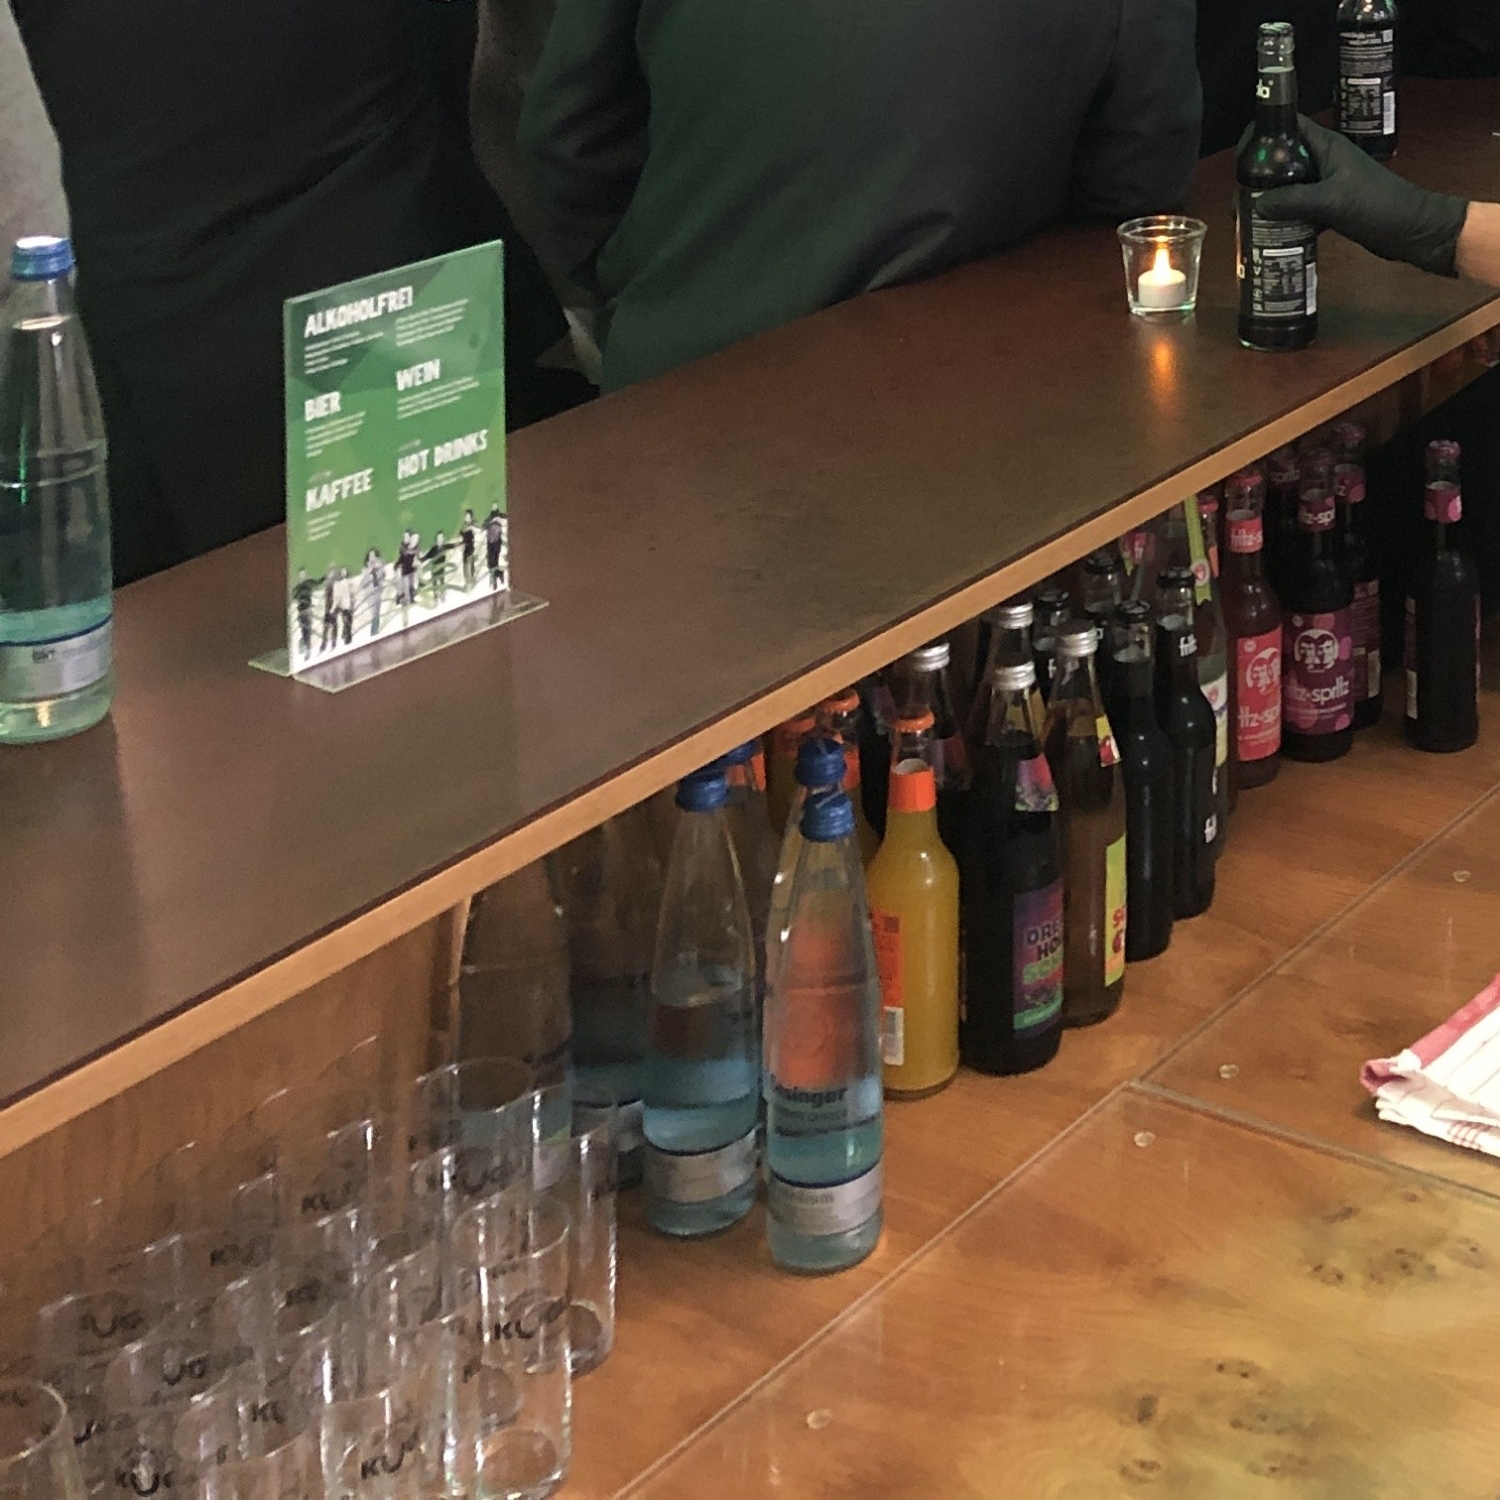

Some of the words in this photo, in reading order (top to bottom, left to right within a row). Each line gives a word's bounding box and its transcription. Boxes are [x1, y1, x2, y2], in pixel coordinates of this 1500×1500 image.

[304, 285, 414, 339] ALKOHOLFREI
[395, 358, 441, 391] WEIN
[397, 447, 429, 480] HOT
[433, 429, 489, 466] DRINKS
[305, 467, 375, 513] KAFFEE
